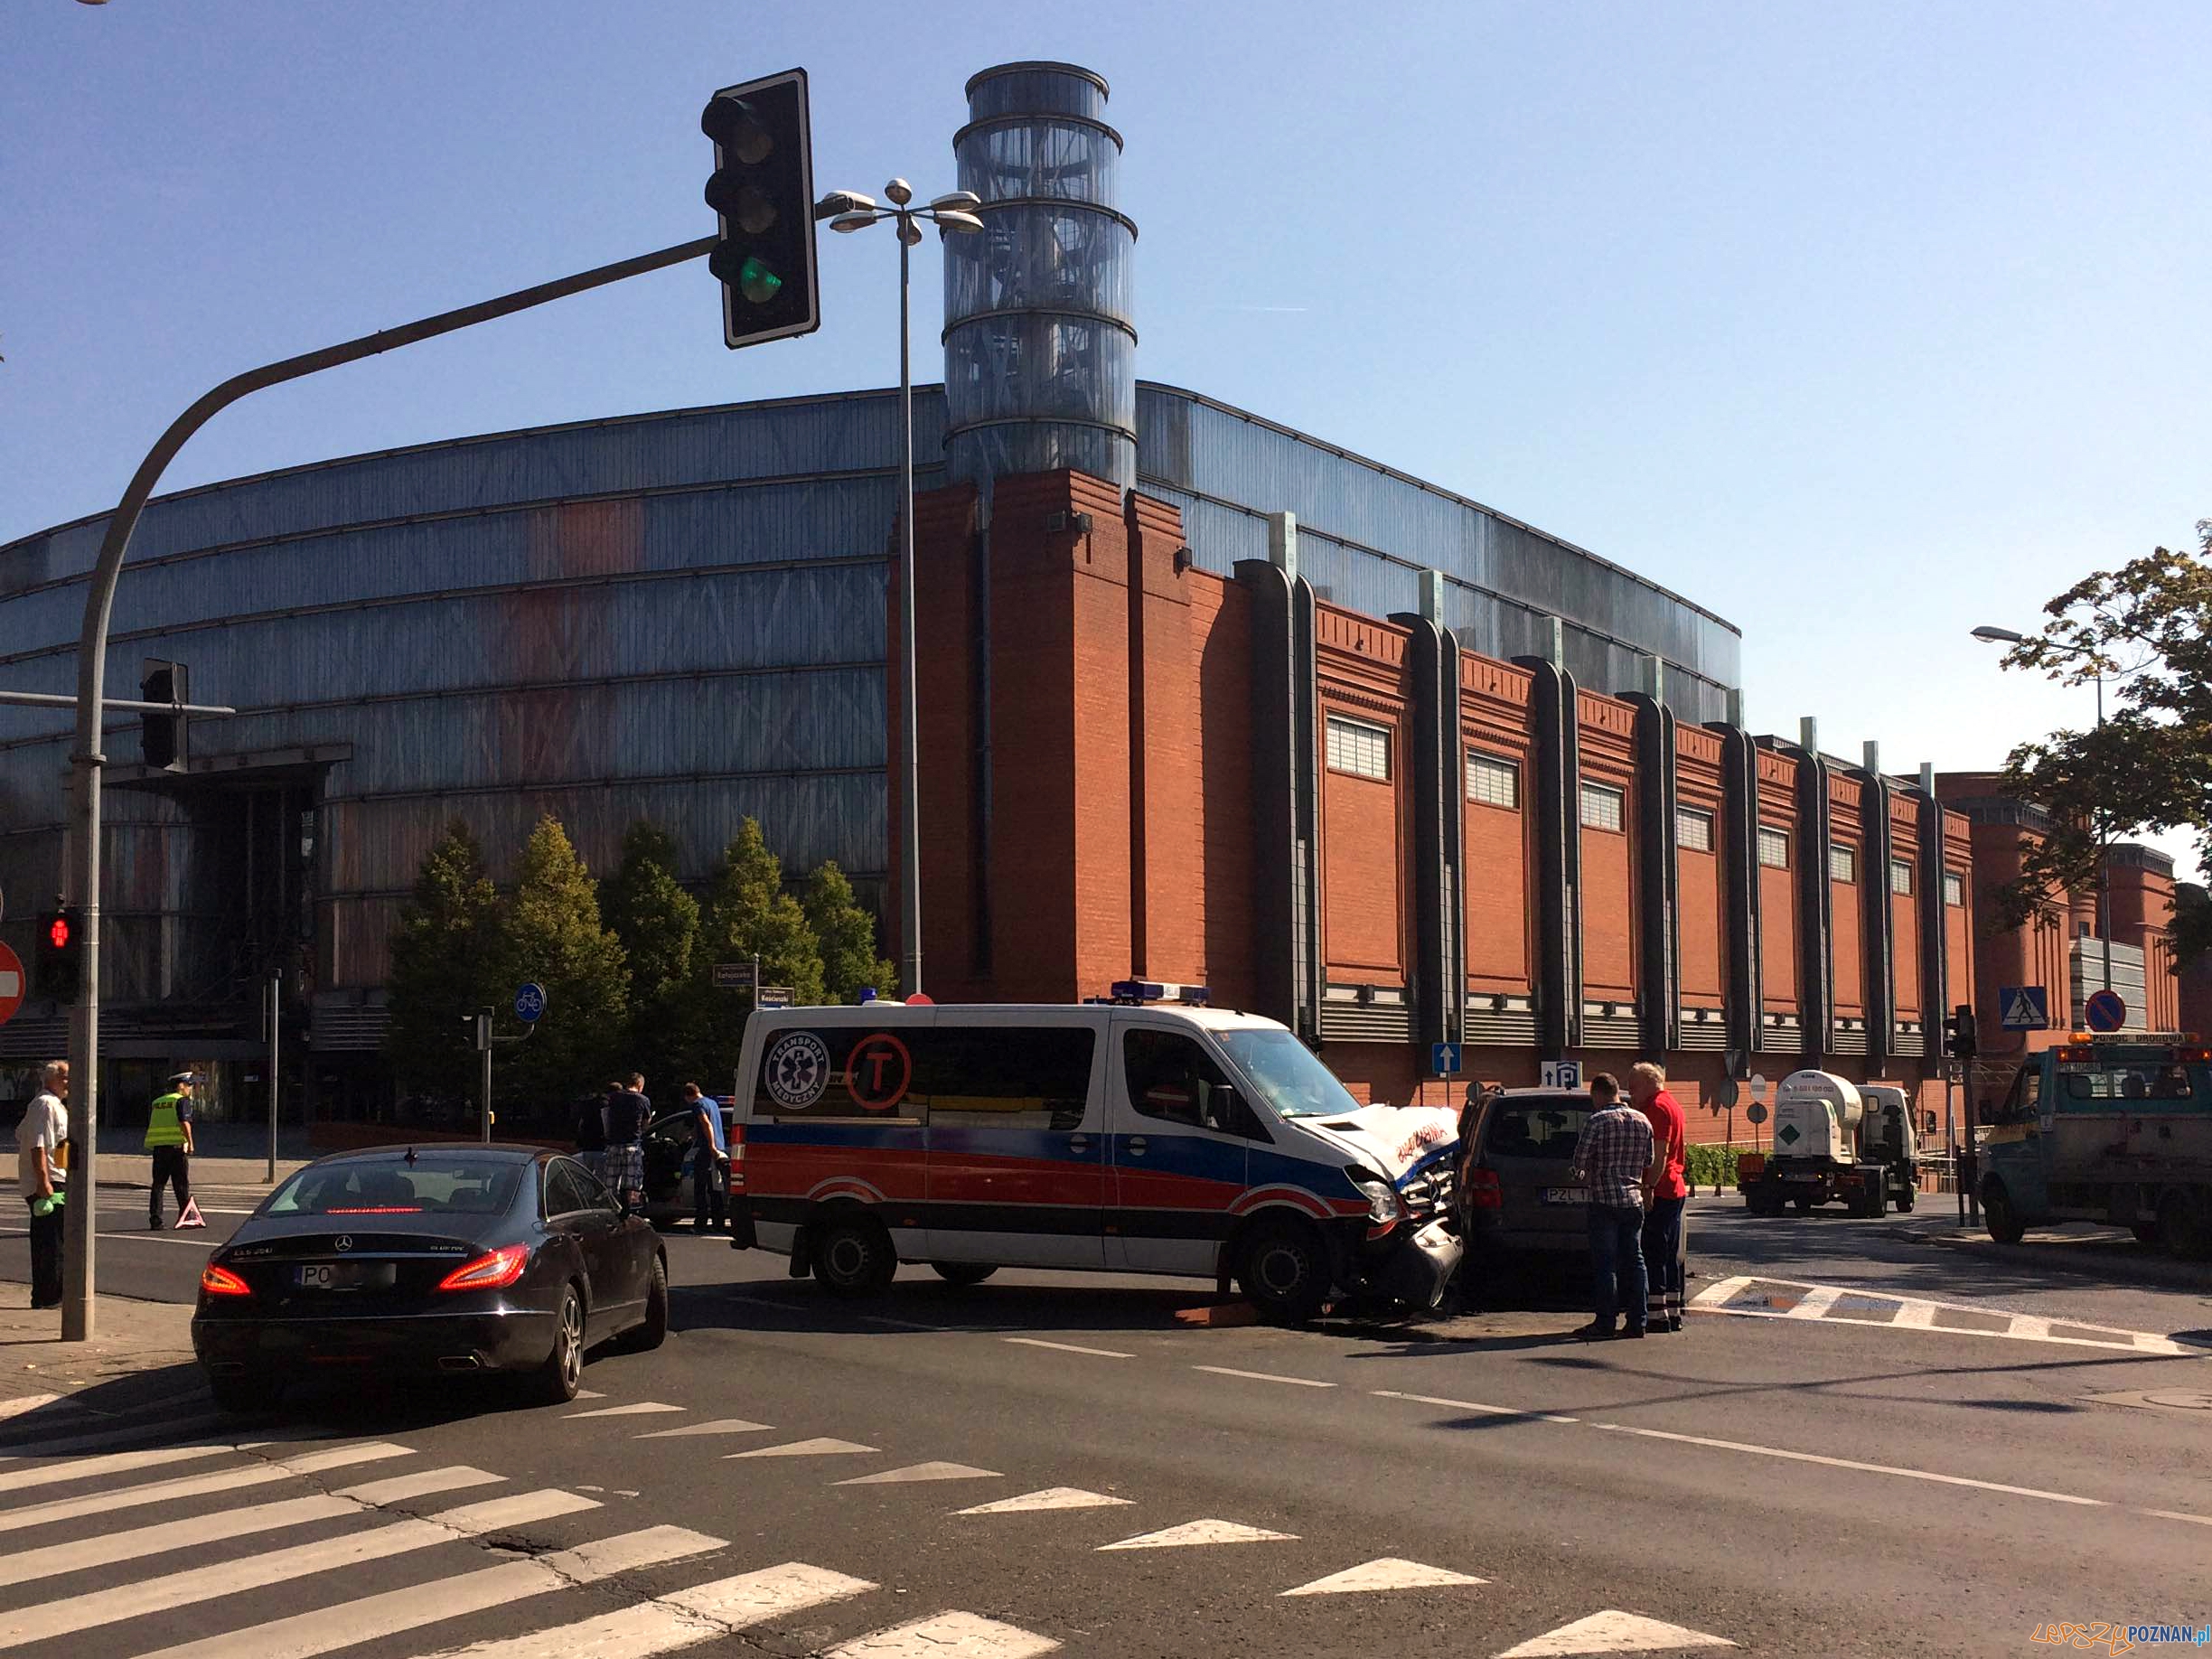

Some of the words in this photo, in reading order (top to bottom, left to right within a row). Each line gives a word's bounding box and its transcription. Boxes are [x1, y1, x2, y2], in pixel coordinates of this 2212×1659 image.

[772, 1038, 825, 1063] TRANSPORT
[867, 1053, 893, 1091] T
[772, 1081, 820, 1103] MEDYCZNY
[1550, 1189, 1574, 1201] PZL
